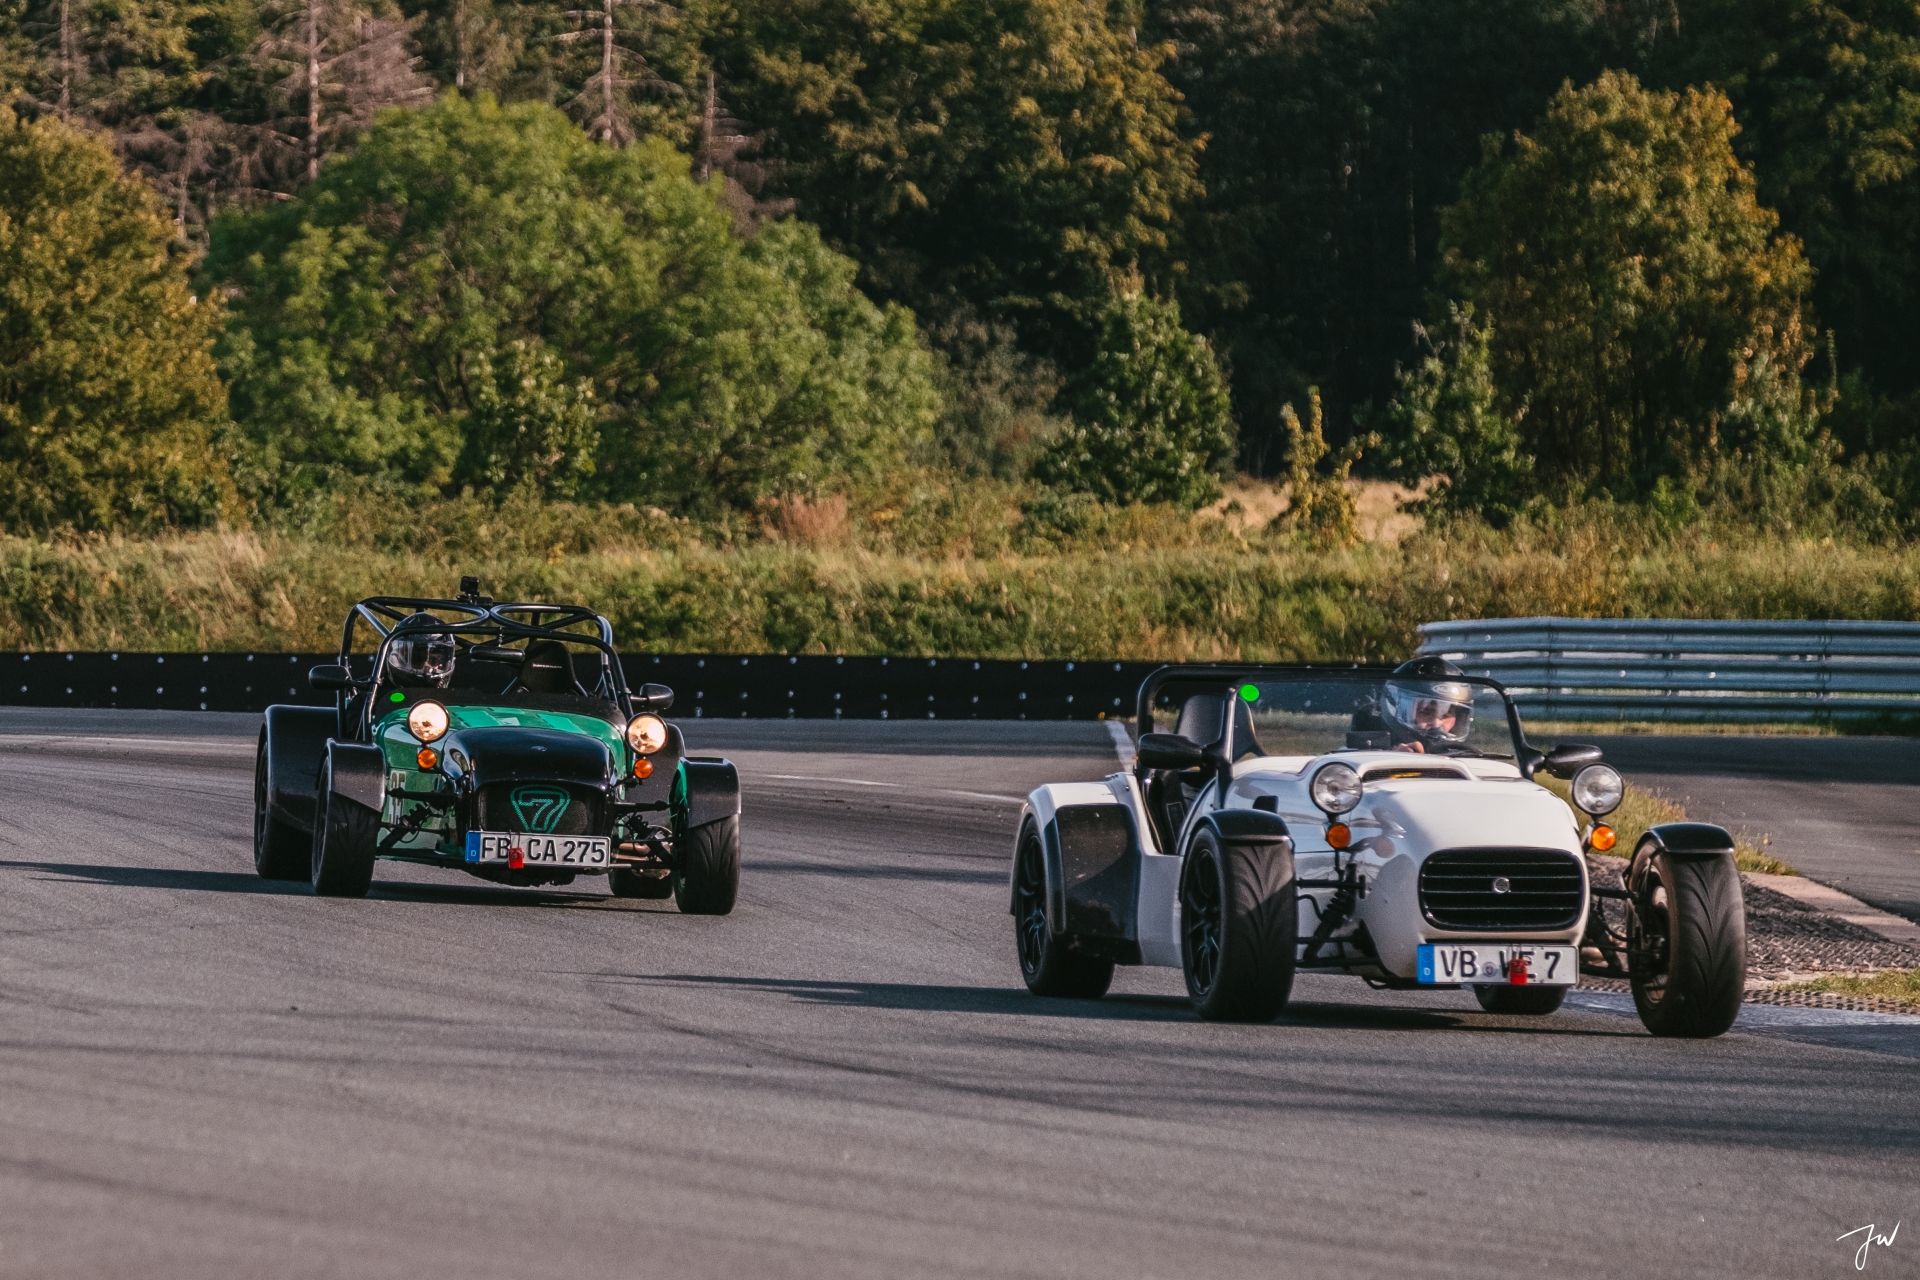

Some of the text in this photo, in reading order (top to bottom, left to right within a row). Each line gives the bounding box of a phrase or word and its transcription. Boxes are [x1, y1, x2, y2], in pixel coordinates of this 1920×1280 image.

[518, 790, 567, 831] 7
[482, 837, 510, 859] FB
[528, 839, 557, 861] CA
[563, 840, 605, 863] 275
[1440, 949, 1477, 978] VB
[1544, 951, 1561, 979] 7
